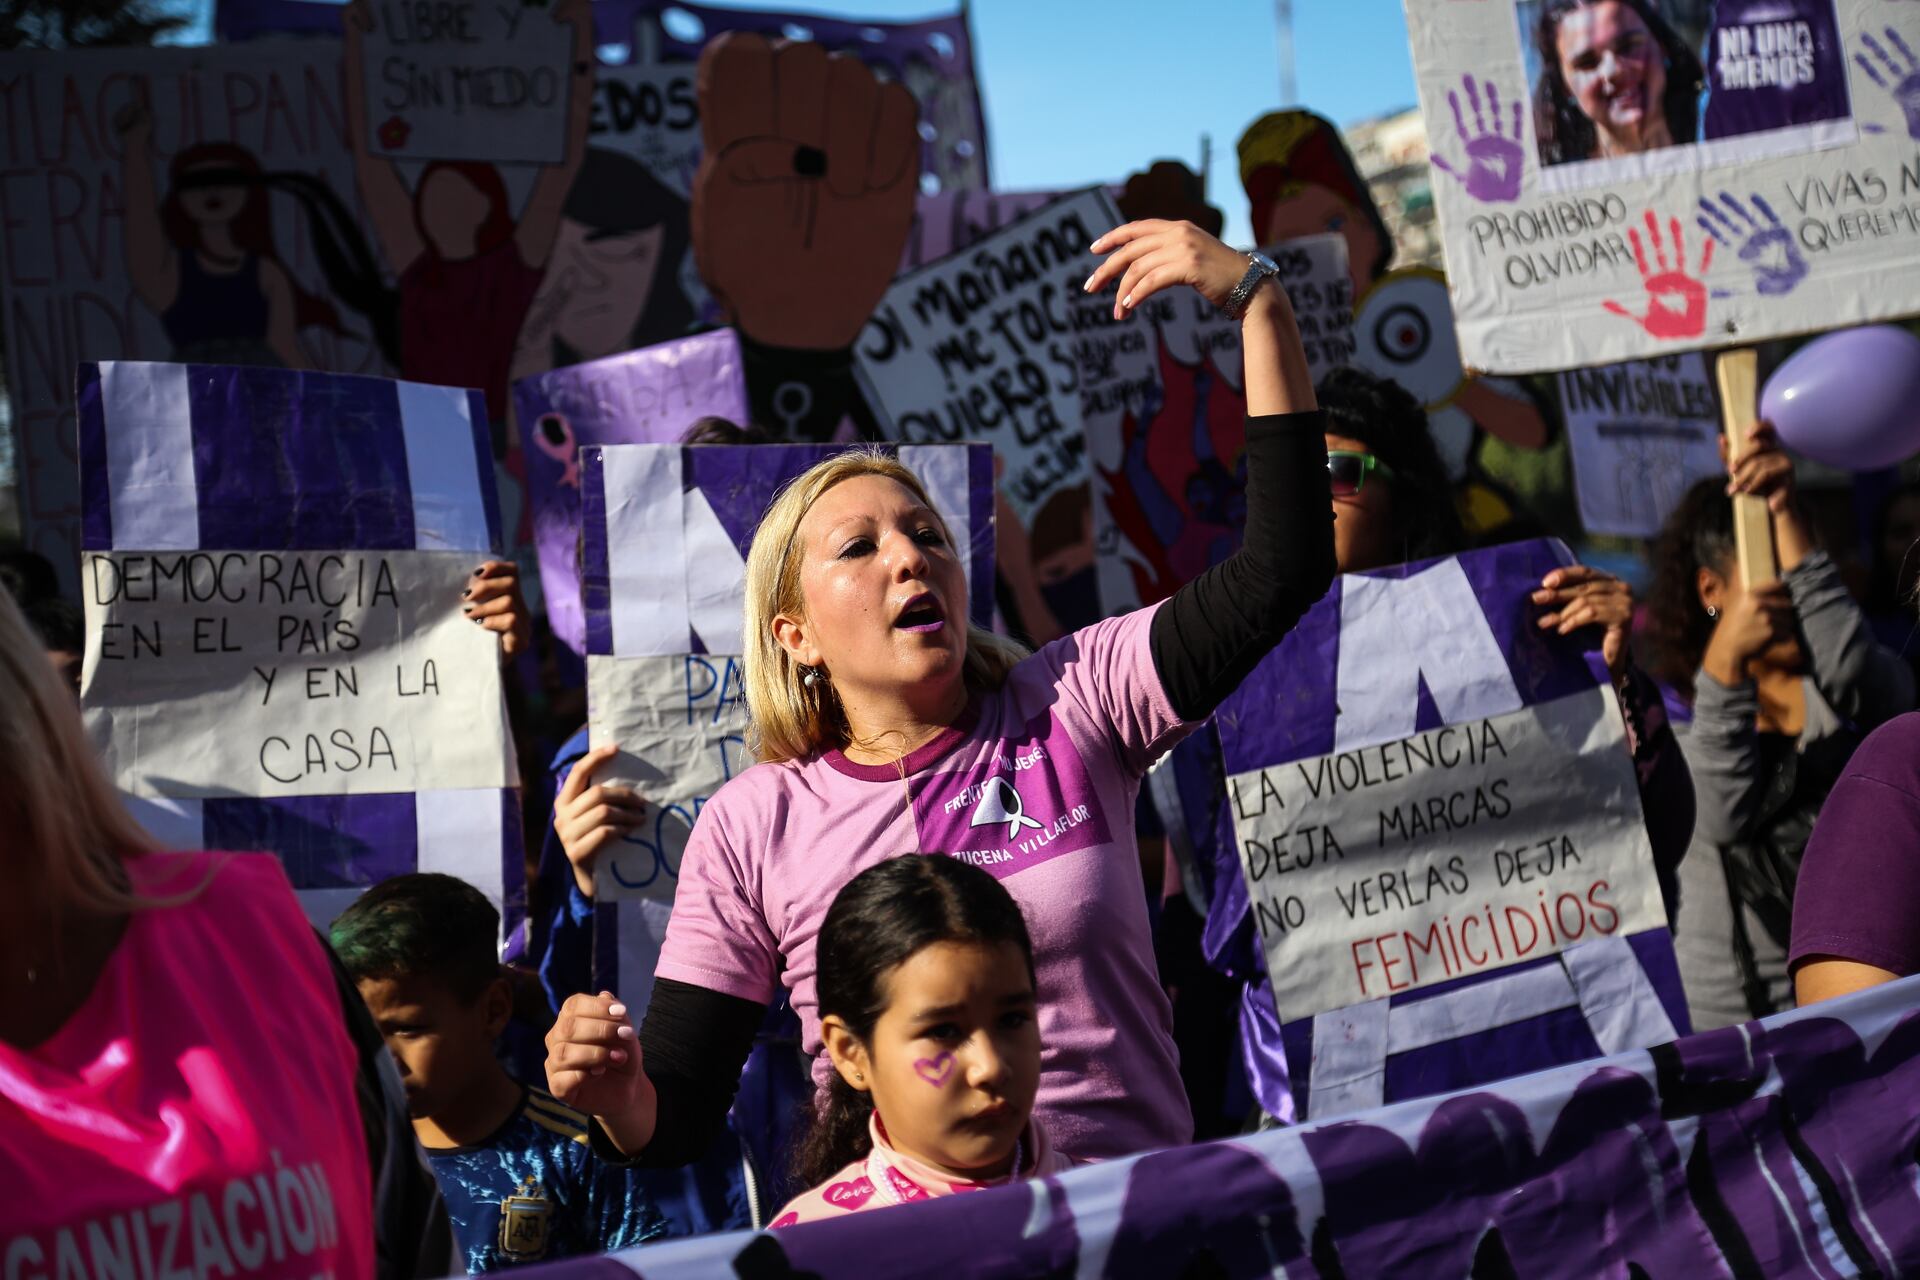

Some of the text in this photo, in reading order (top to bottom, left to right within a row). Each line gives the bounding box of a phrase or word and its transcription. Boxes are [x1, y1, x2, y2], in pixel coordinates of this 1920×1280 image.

[92, 552, 400, 608] DEMOCRACIA
[100, 610, 361, 661] EN EL PAÍS
[253, 658, 440, 706] Y EN LA
[686, 655, 747, 726] PA
[259, 726, 397, 783] CASA
[1233, 717, 1508, 821] LA VIOLENCIA
[951, 804, 1091, 866] ZUCENA VILLAFLOR
[1246, 780, 1512, 883] DEJA MARCAS
[1255, 834, 1582, 940] NO VERLAS DEJA
